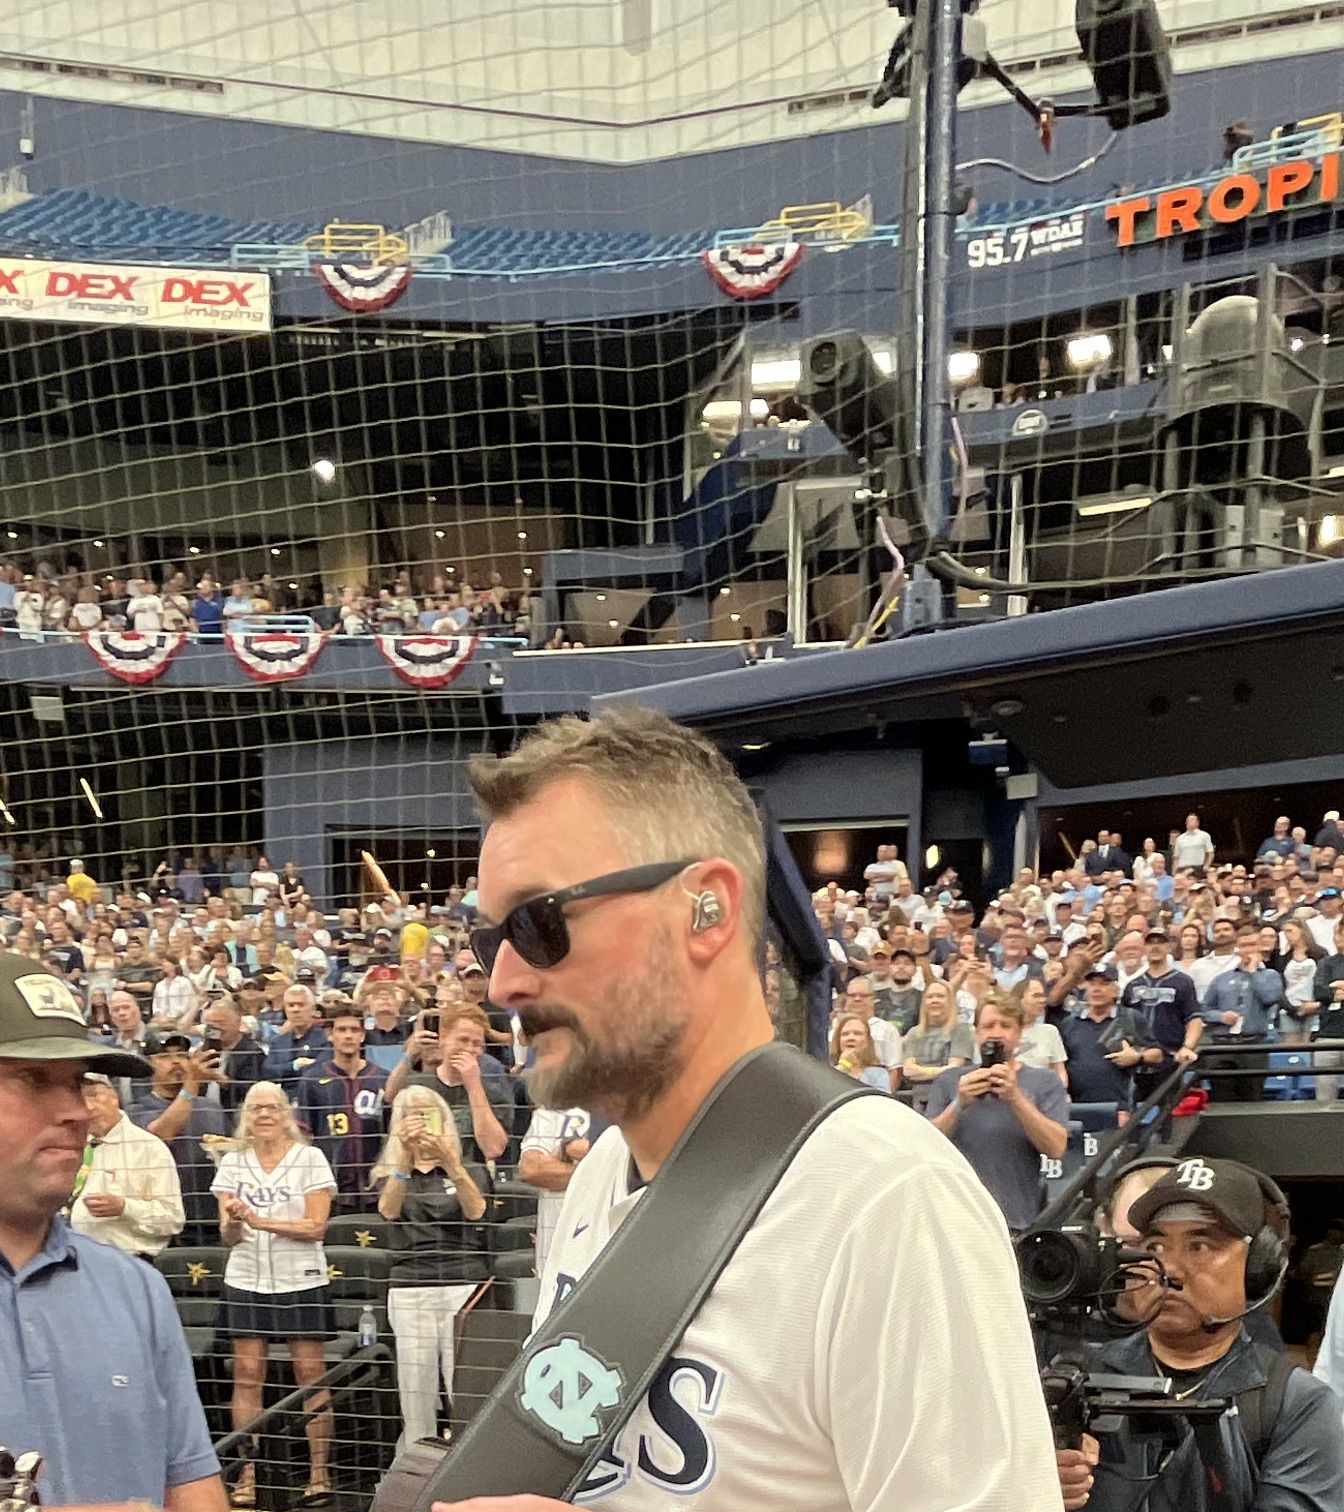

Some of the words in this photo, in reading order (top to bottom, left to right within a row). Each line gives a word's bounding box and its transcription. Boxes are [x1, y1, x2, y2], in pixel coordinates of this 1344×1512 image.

[967, 231, 1030, 269] 95.7
[46, 272, 140, 301] DEX
[161, 278, 255, 307] DEX
[326, 1112, 350, 1136] 13
[1176, 1158, 1215, 1191] TB
